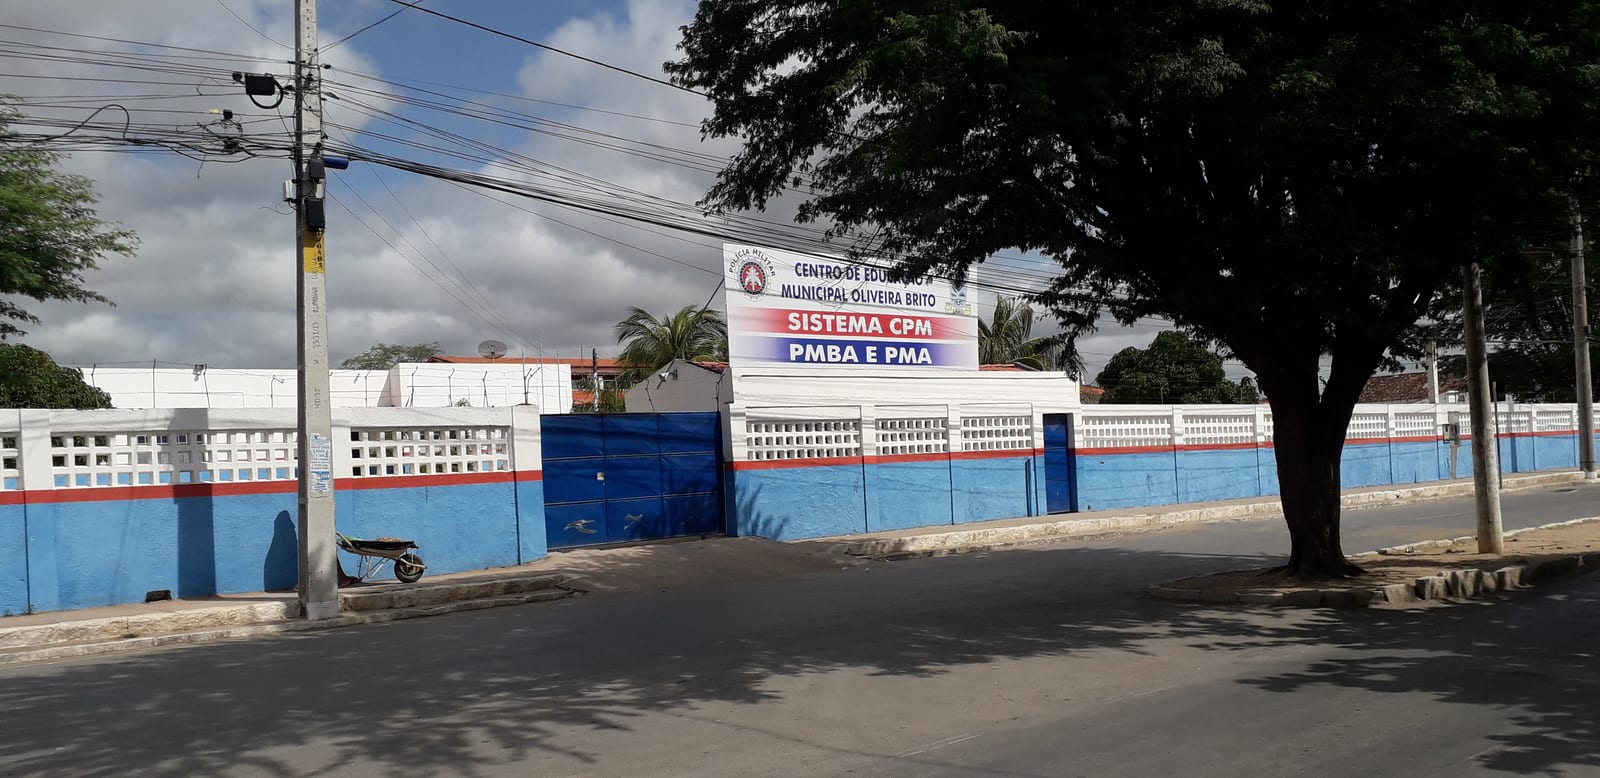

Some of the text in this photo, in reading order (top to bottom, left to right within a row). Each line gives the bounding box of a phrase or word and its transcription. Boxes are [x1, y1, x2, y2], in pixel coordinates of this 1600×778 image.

[752, 249, 776, 276] MILITAR
[795, 262, 923, 287] CENTRO DE EDUO
[781, 284, 936, 307] MUNICIPAL OLIVEIRA BRITO
[788, 312, 933, 336] SISTEMA CPM
[789, 343, 933, 364] PMBA E PMA
